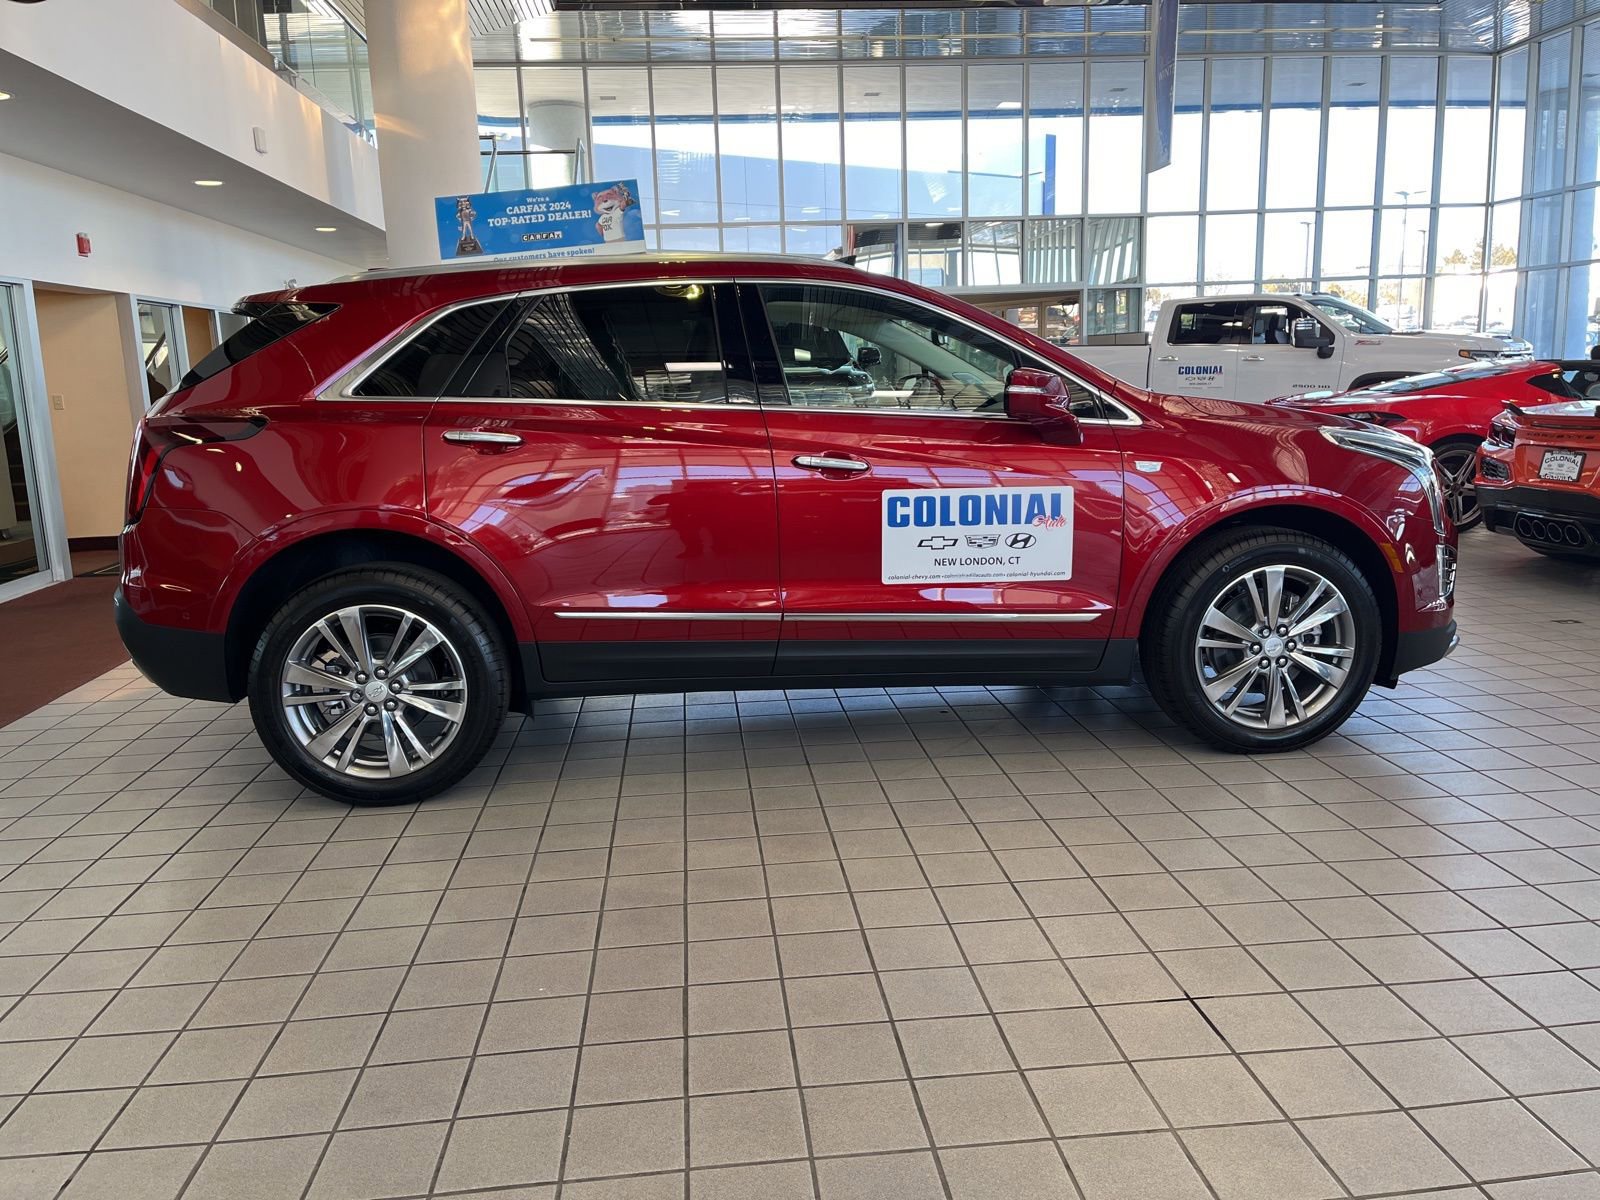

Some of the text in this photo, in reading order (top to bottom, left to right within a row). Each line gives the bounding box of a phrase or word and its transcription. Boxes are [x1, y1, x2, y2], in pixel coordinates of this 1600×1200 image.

[506, 201, 571, 214] CARFAX 2024
[488, 210, 592, 226] TOP-RATED DEALER!
[522, 231, 563, 242] CARFAX
[508, 253, 547, 262] customers
[567, 247, 595, 257] spoken!
[1178, 365, 1223, 375] COLONIAL
[1545, 456, 1579, 467] COLONIAL
[887, 493, 1062, 528] COLONIAL
[1032, 514, 1067, 530] Auto
[934, 556, 1021, 567] NEW LONDON, CT
[888, 573, 941, 581] colonial-chevy.com
